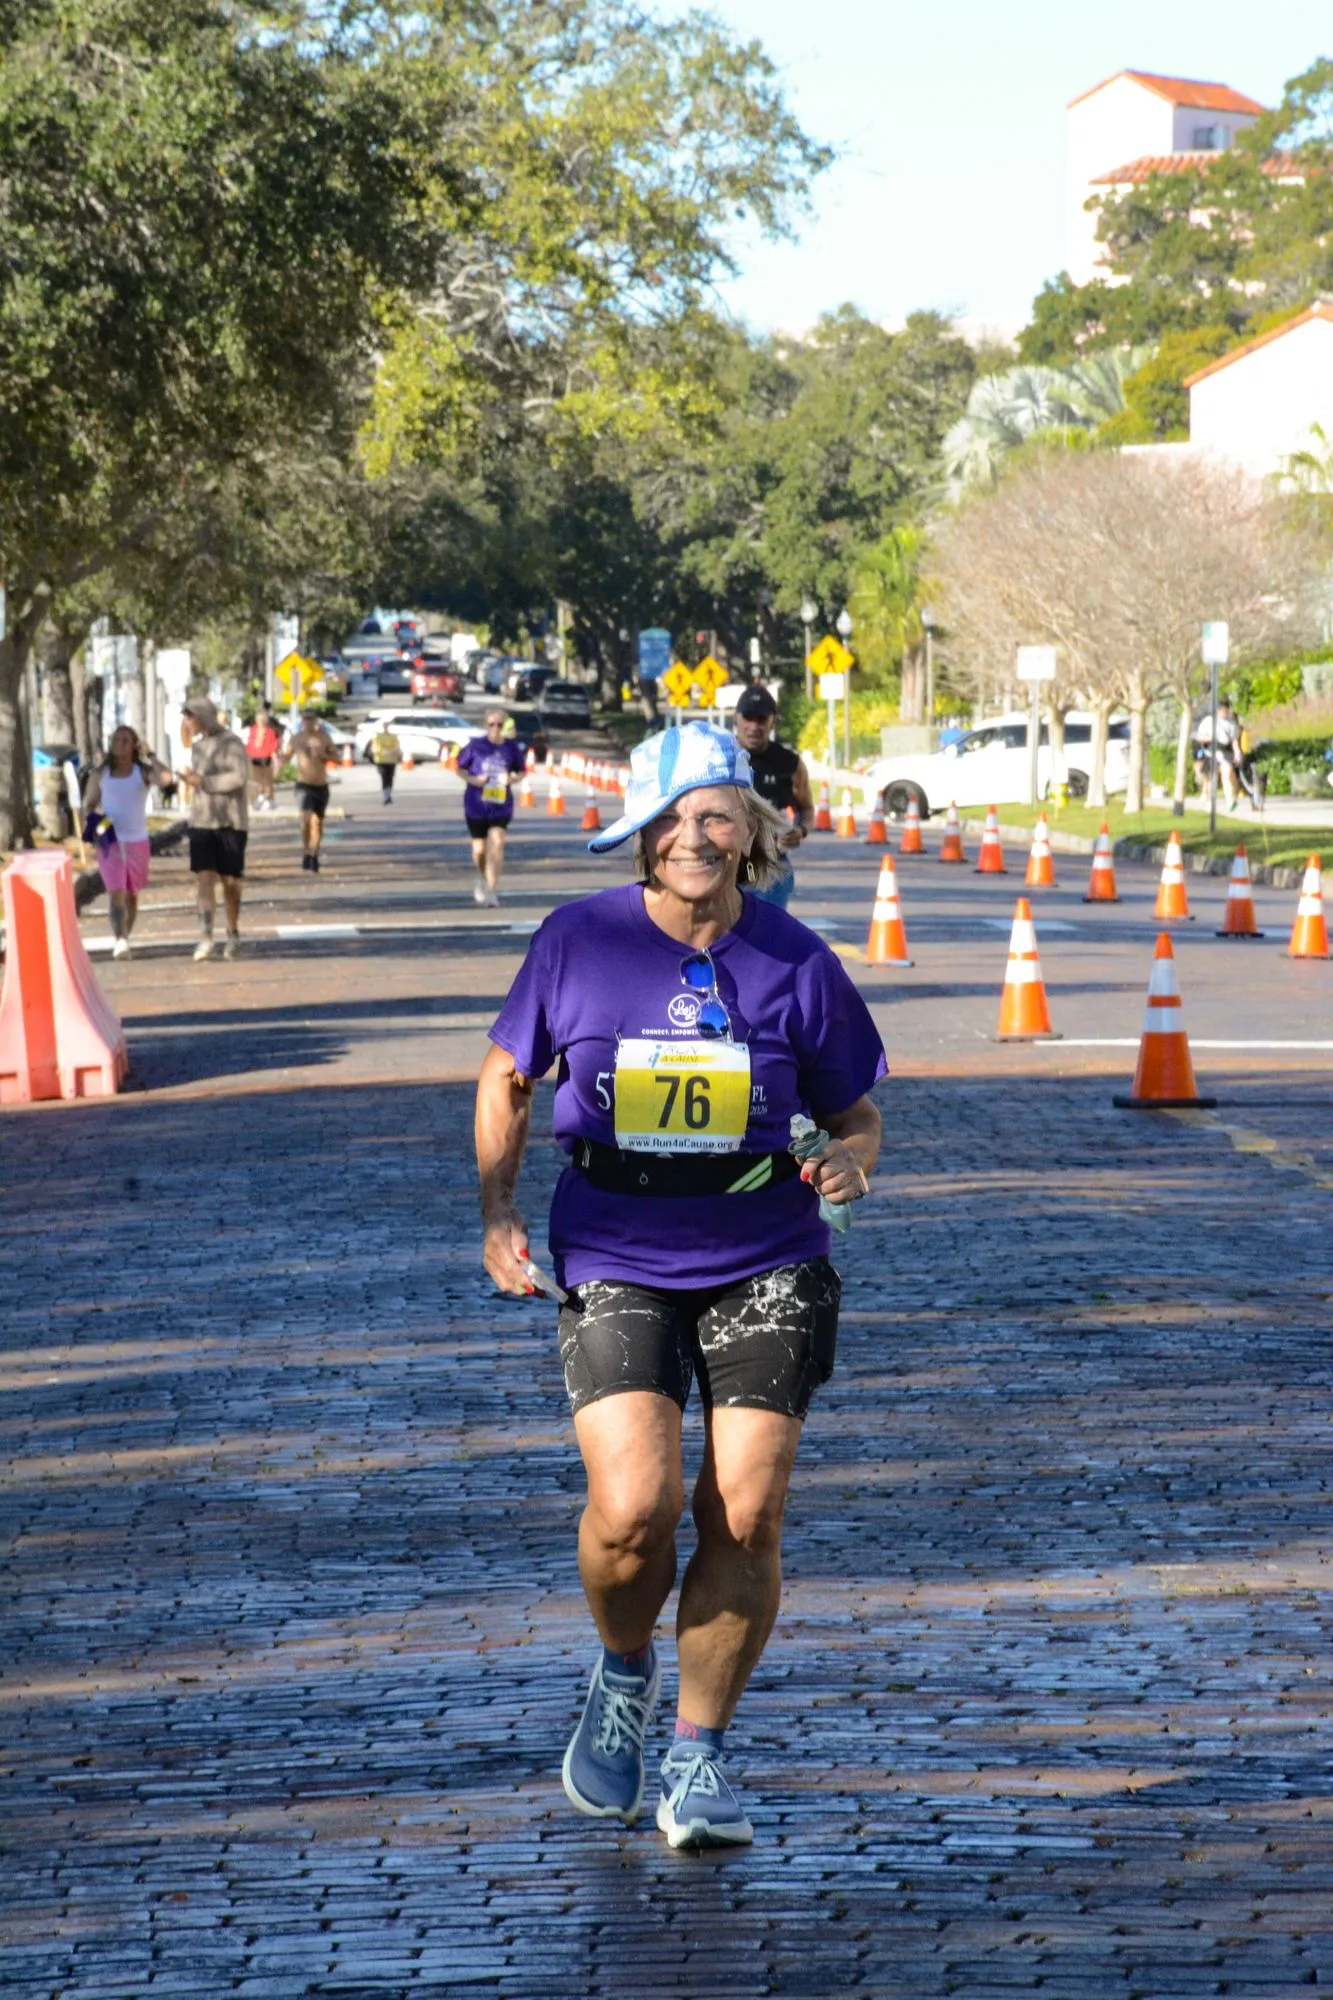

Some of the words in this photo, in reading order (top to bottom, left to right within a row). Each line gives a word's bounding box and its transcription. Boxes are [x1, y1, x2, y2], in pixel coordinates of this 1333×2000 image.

[752, 1085, 767, 1102] FL
[655, 1075, 711, 1130] 76
[628, 1138, 733, 1151] www.Run4aCause.org
